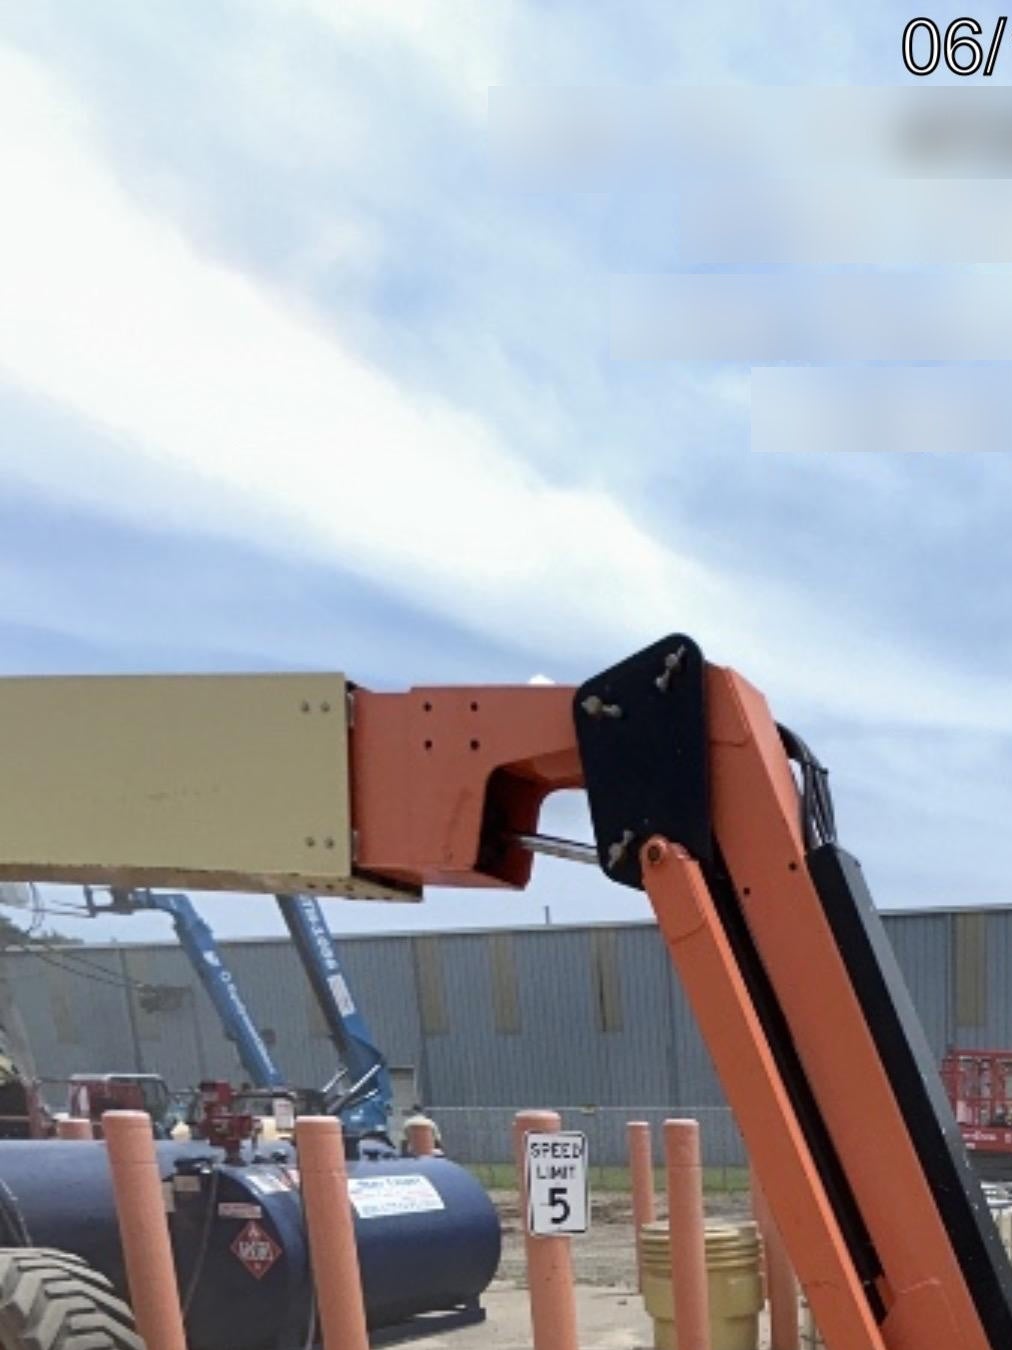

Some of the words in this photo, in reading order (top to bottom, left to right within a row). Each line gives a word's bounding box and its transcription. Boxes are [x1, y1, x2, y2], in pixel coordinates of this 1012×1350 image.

[530, 1142, 582, 1159] SPEED
[536, 1164, 576, 1179] LIMIT
[548, 1186, 571, 1224] 5
